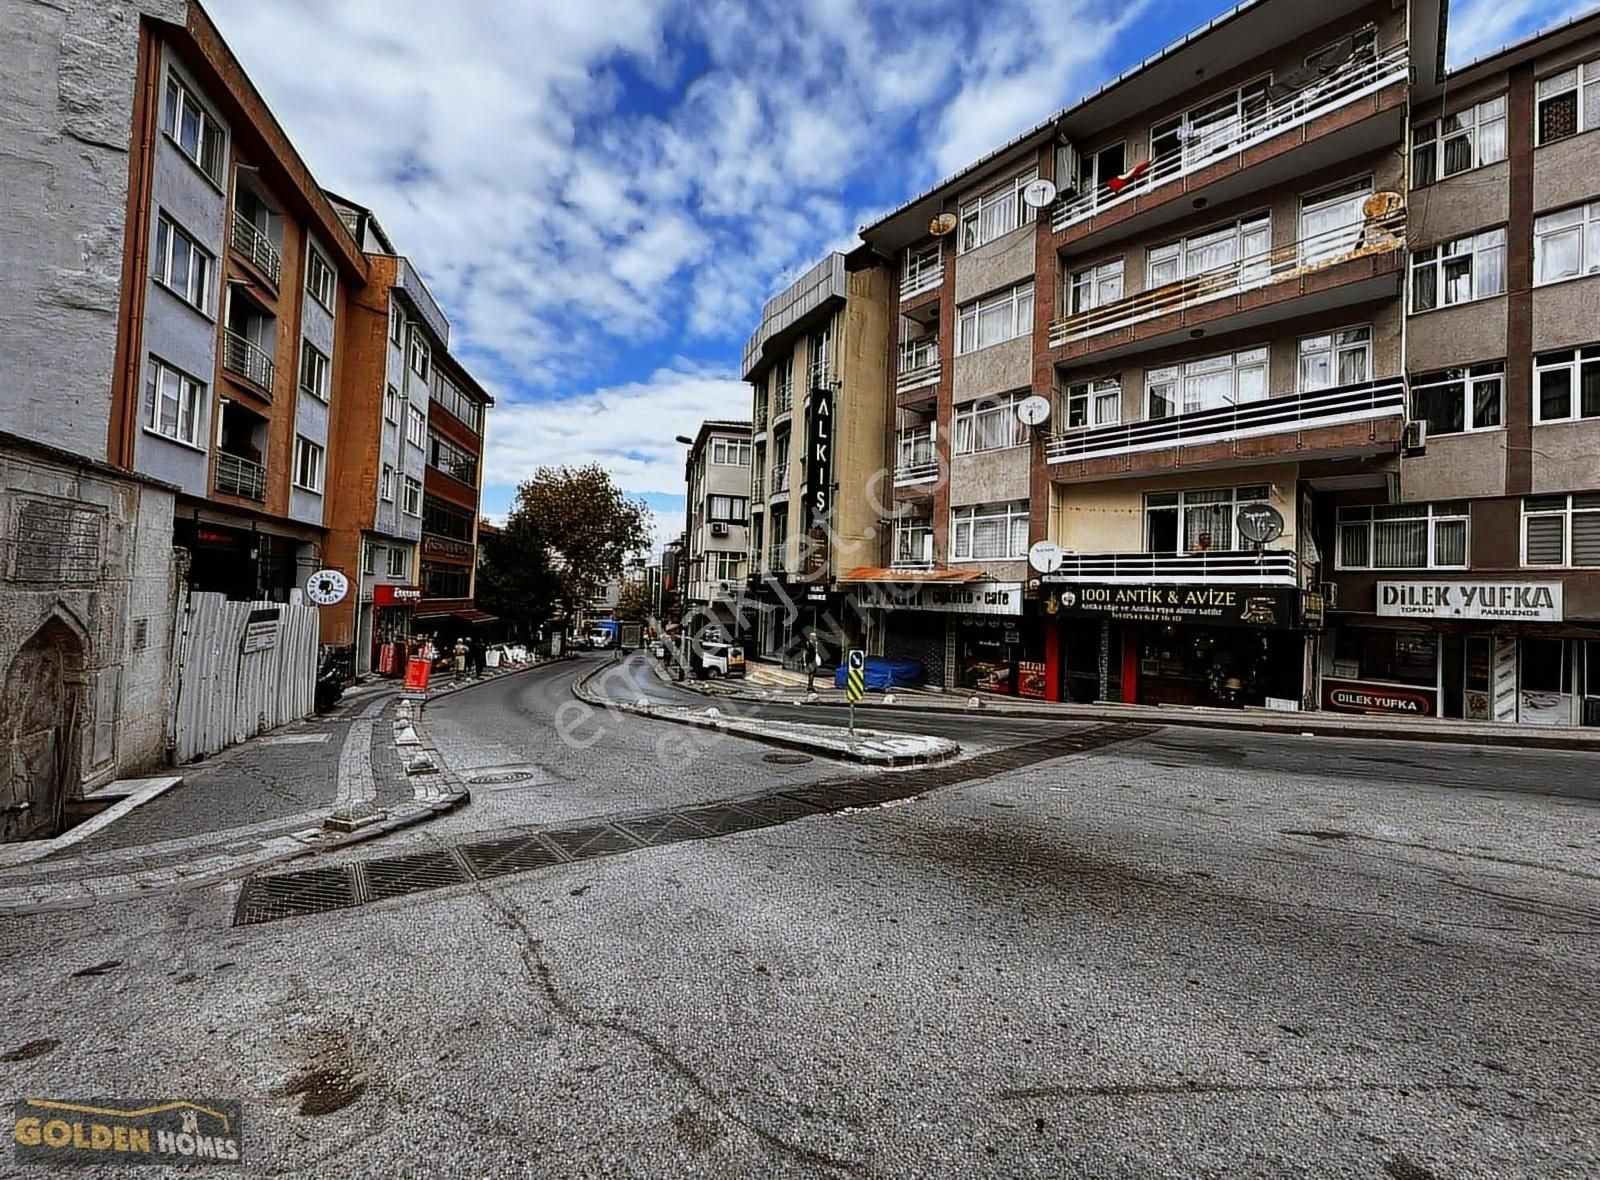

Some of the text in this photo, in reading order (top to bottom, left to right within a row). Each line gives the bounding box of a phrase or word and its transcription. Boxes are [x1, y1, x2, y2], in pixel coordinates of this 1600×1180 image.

[816, 398, 829, 511] ALKIŞ
[984, 591, 1009, 605] cafe
[1081, 587, 1236, 606] 1001 ANTİK & AVİZE
[1460, 586, 1554, 609] YUFKA
[1373, 697, 1417, 711] YUFKA
